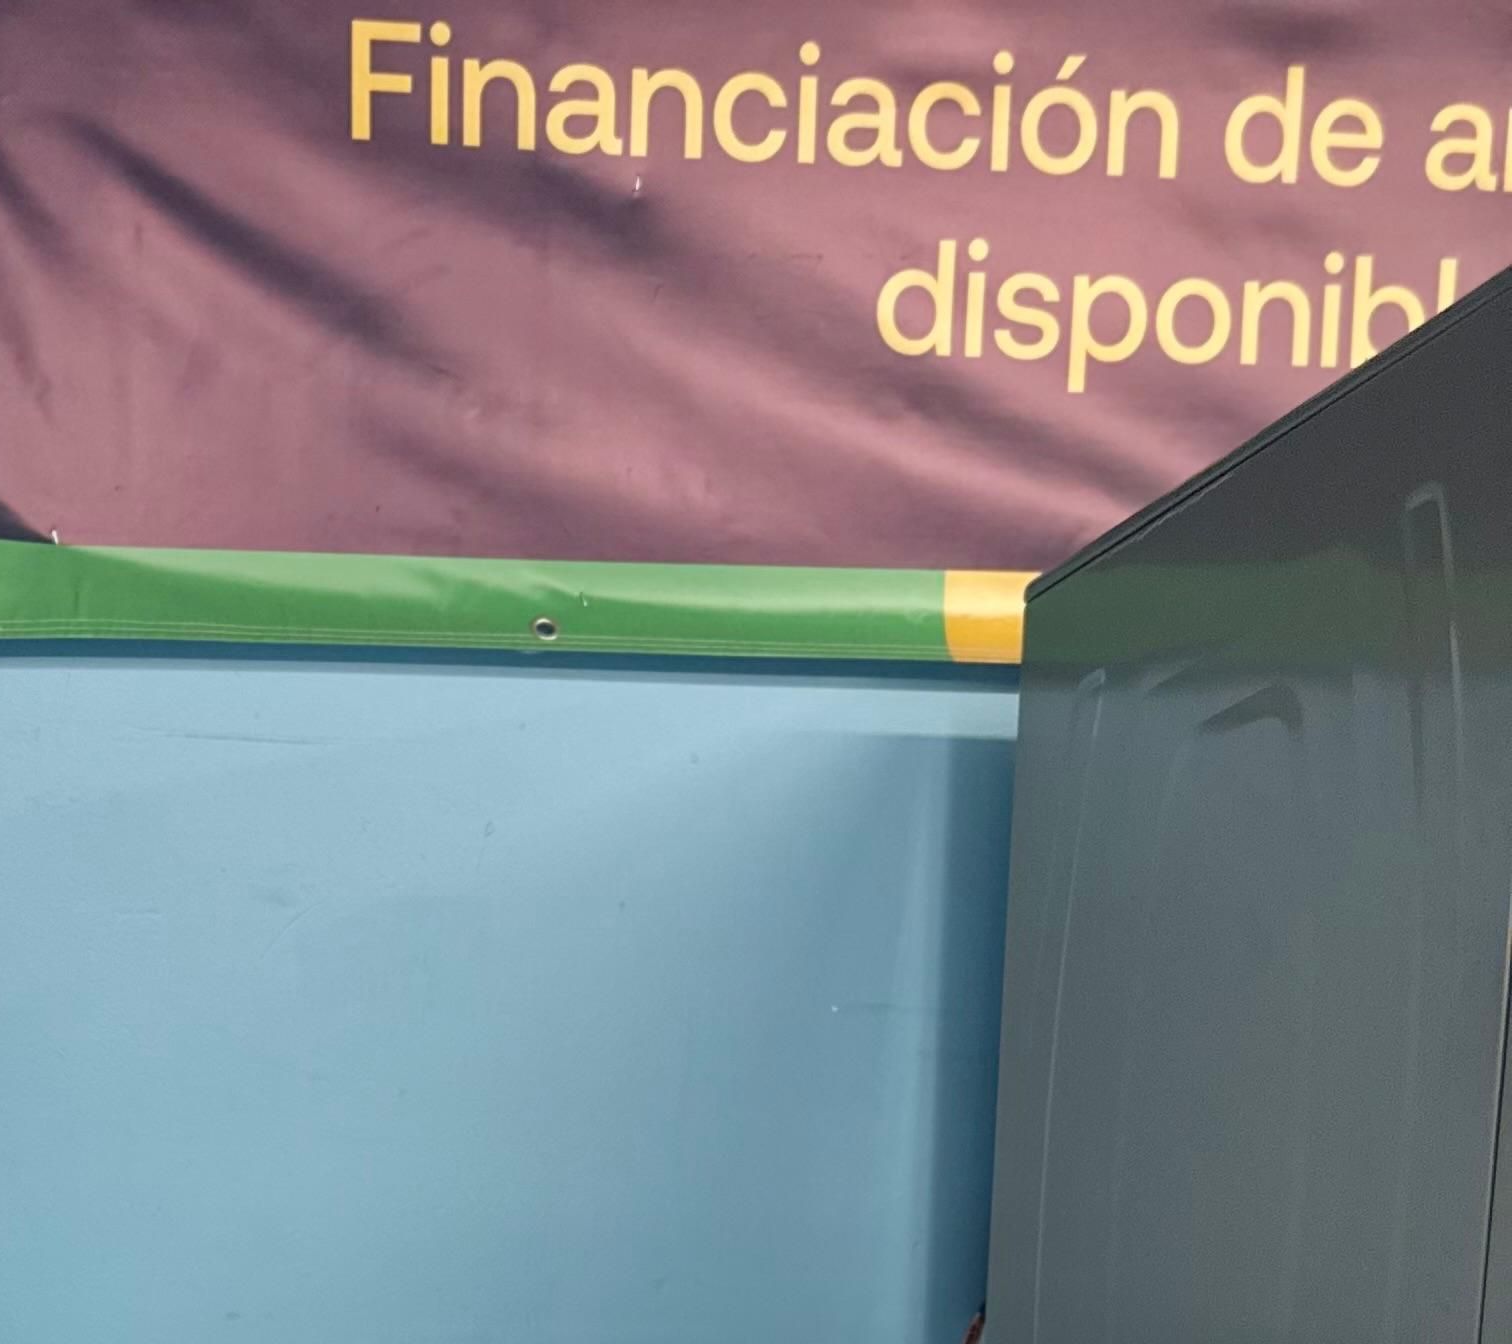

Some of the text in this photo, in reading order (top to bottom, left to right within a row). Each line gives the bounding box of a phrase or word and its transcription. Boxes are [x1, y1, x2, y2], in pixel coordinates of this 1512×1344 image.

[350, 19, 1512, 193] Financiación de a
